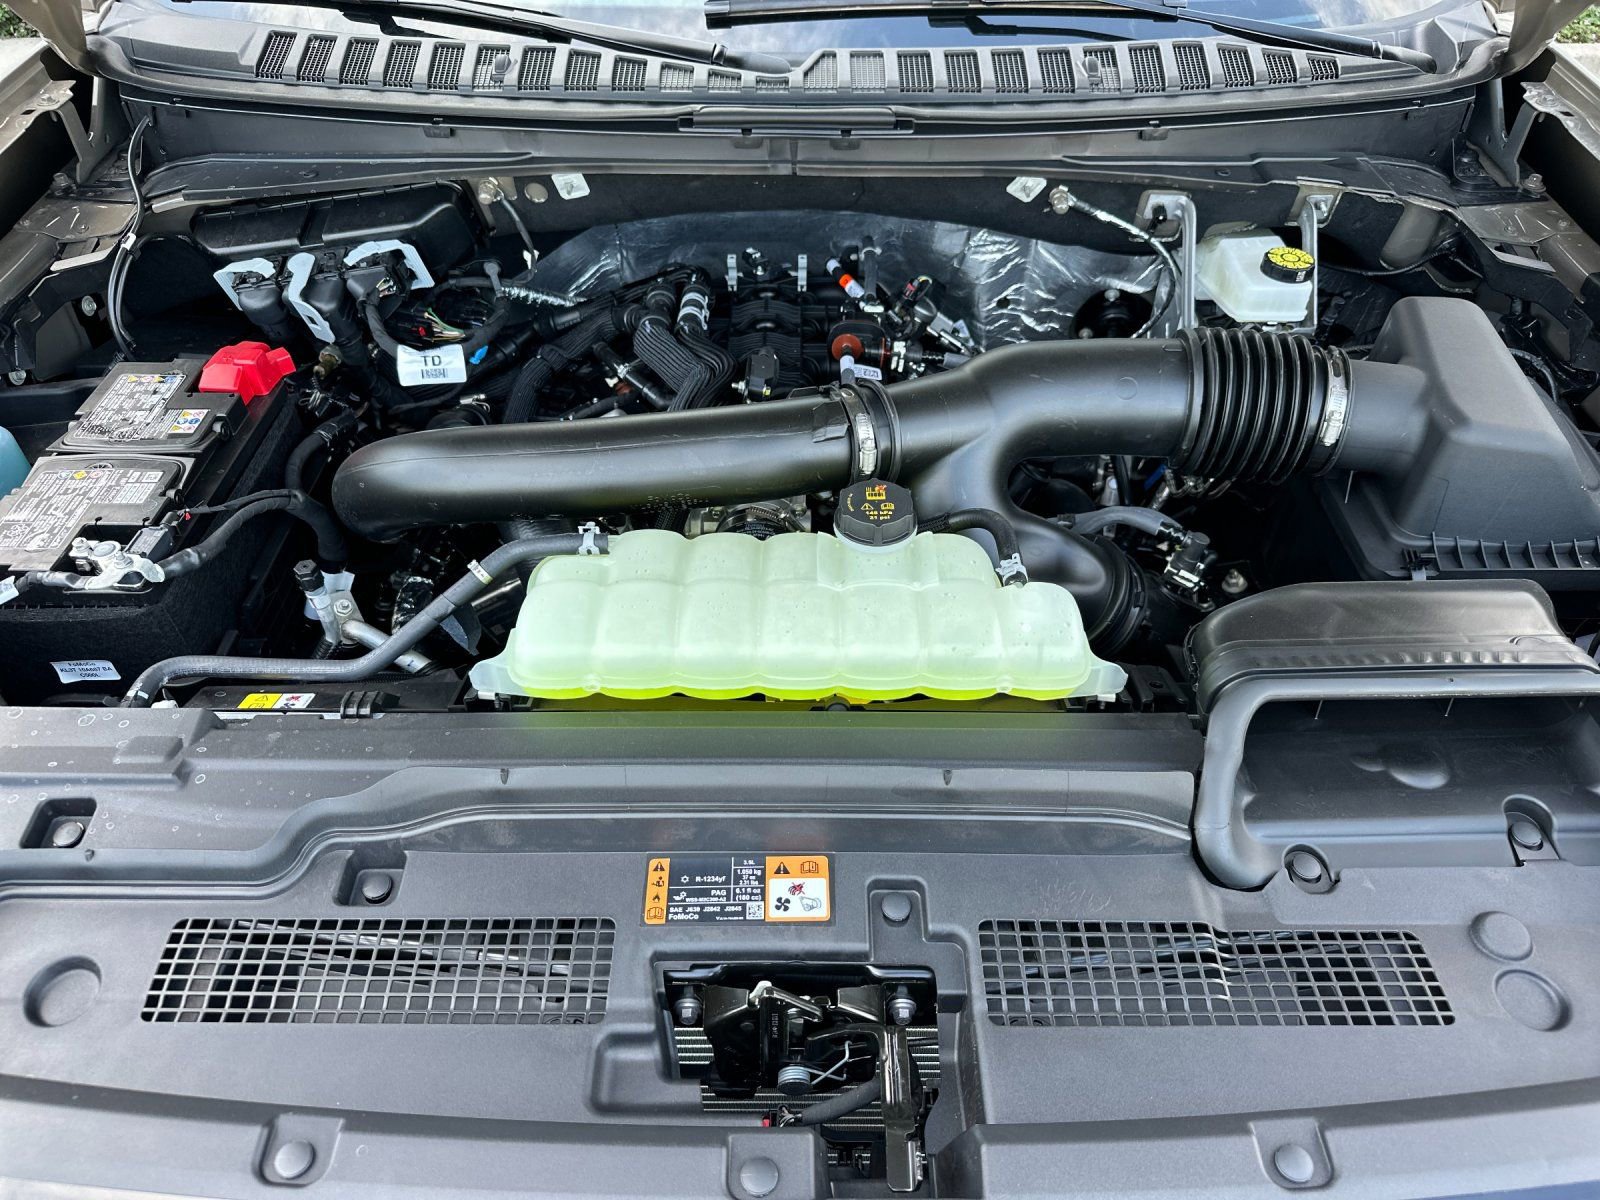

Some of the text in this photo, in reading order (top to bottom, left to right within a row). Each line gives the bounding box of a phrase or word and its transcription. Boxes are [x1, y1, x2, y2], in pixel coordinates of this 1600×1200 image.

[420, 355, 442, 367] TD
[753, 868, 762, 876] kg
[695, 875, 727, 883] R-1234yf
[668, 913, 699, 921] FoMoCo
